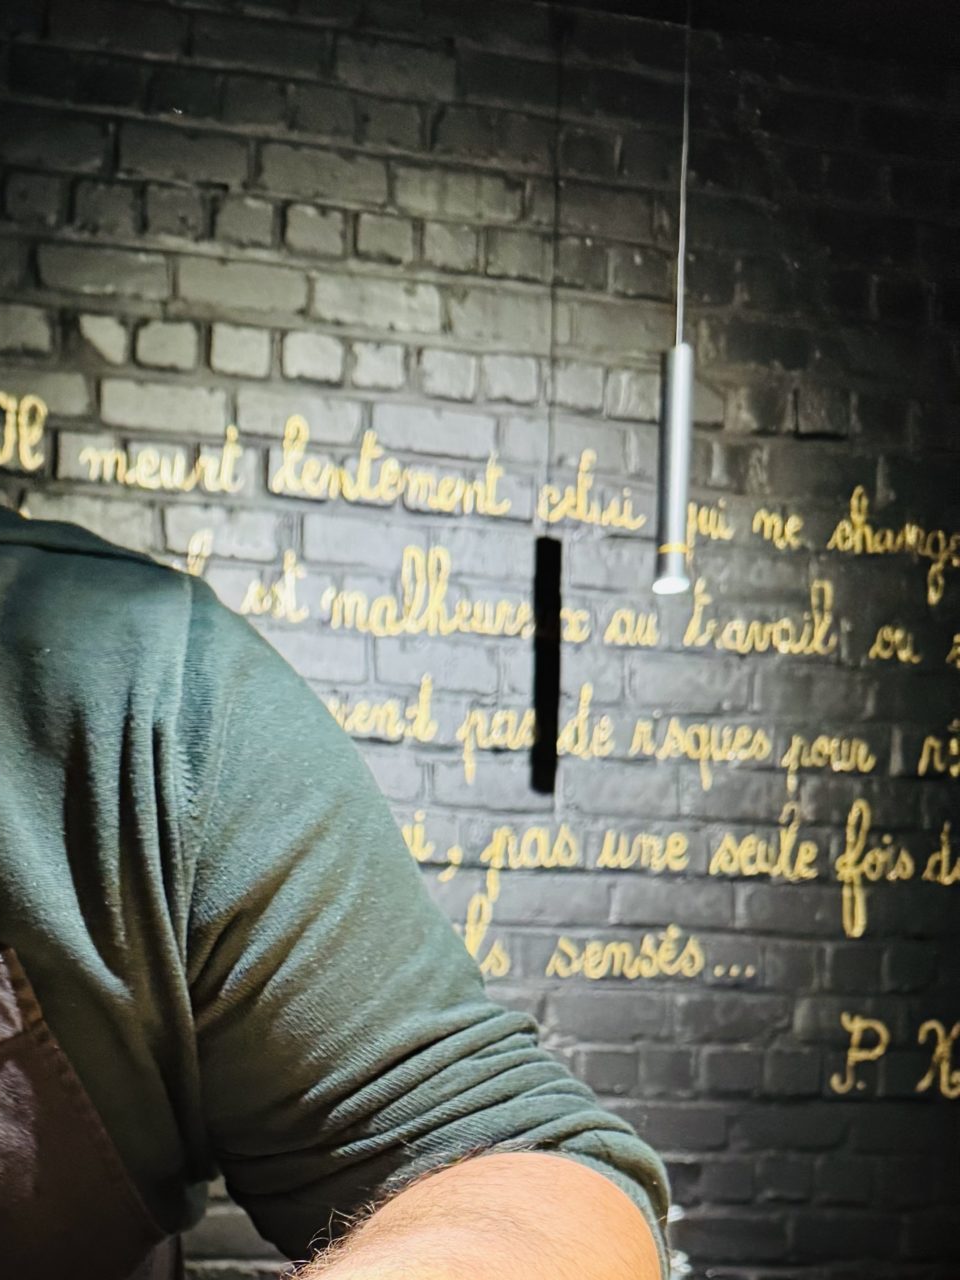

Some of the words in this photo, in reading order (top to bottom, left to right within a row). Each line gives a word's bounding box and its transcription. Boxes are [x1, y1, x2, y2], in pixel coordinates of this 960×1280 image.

[79, 424, 247, 493] meurt
[272, 414, 512, 517] lentement
[677, 497, 735, 568] ui
[752, 507, 804, 551] ne
[603, 607, 661, 648] au
[683, 575, 838, 657] travail
[556, 682, 615, 760] de
[628, 709, 772, 792] risques
[781, 733, 877, 795] pour
[479, 822, 580, 903] pas
[596, 828, 692, 873] une
[708, 801, 820, 883] seule
[835, 798, 915, 939] fois
